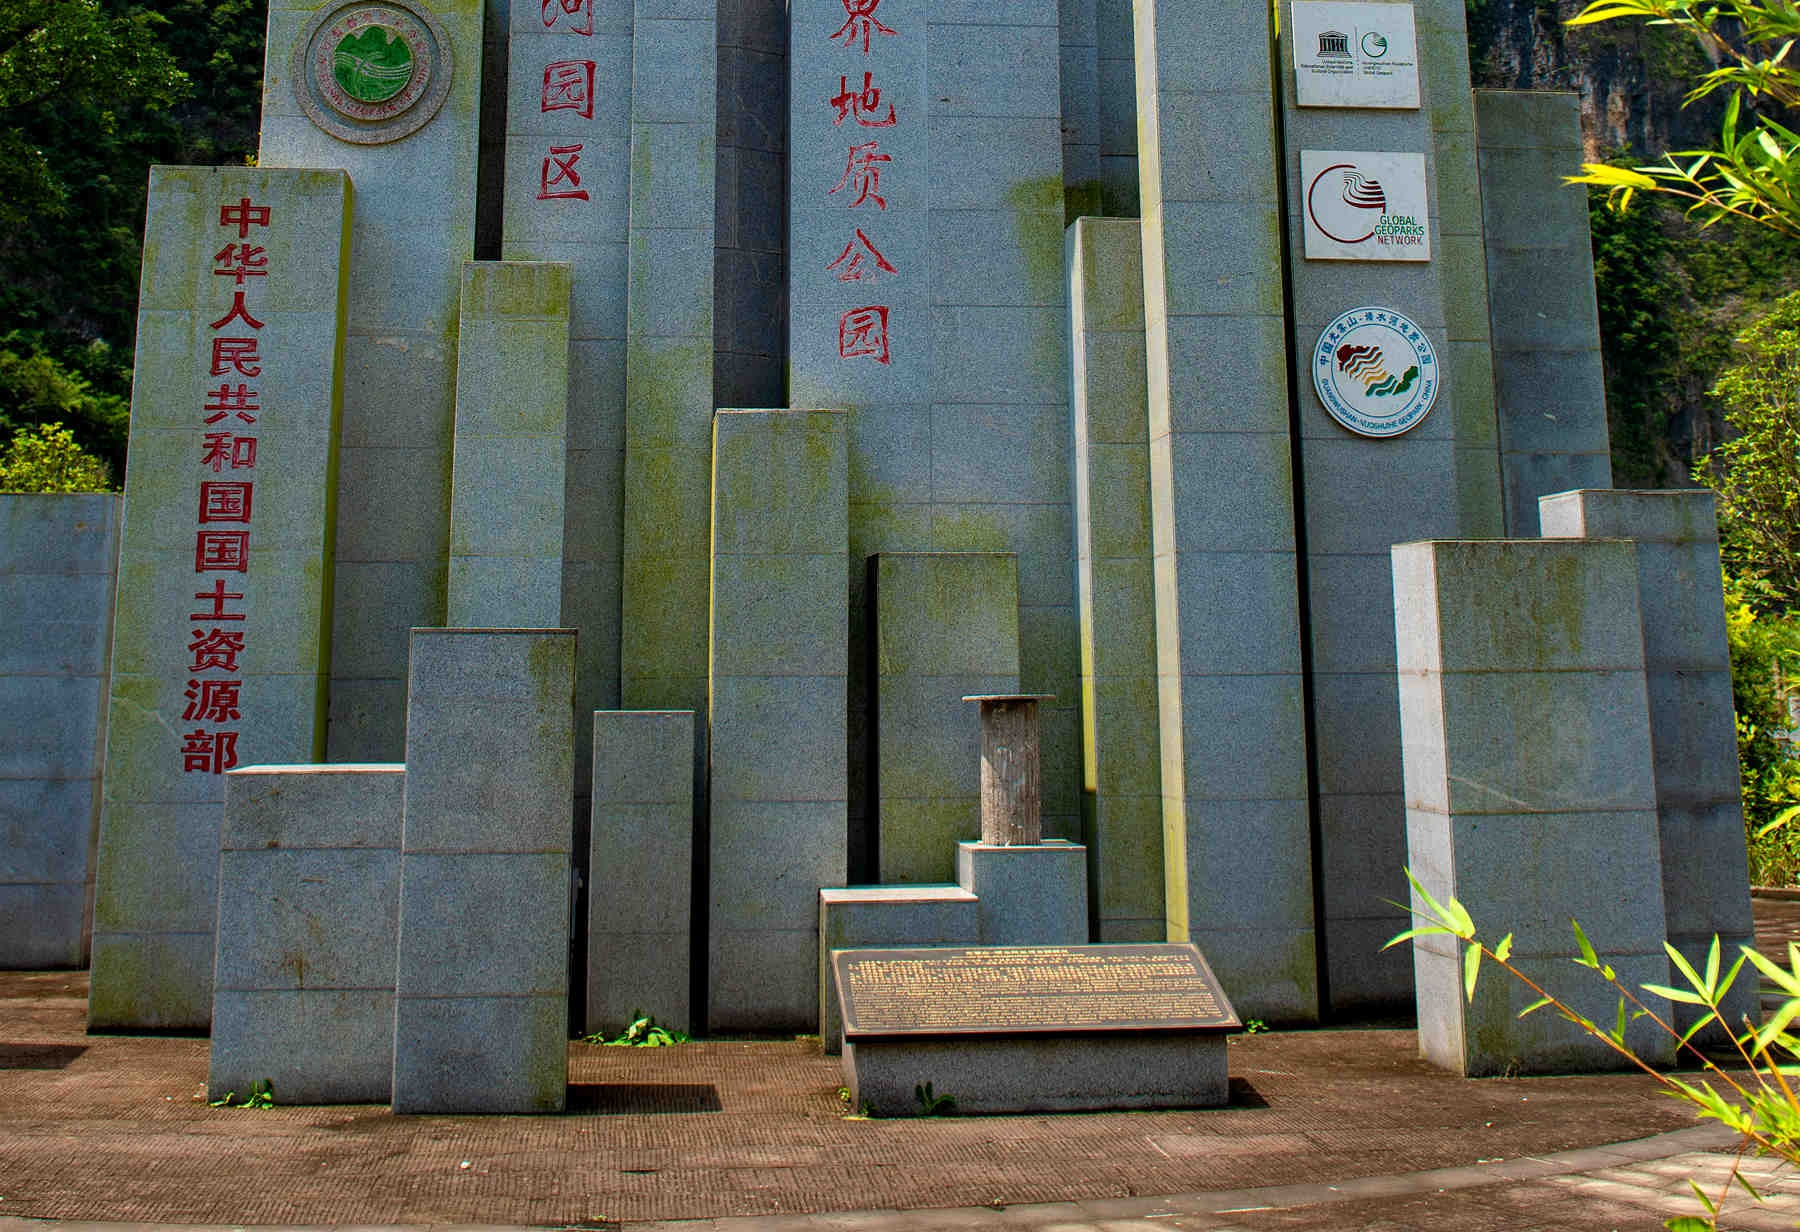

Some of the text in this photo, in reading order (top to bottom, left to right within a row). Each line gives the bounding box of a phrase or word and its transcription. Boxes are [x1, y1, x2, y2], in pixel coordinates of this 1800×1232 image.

[1380, 215, 1418, 225] GLOBAL
[1375, 225, 1425, 236] GEOPARKS
[1377, 235, 1424, 245] NETWORK
[181, 198, 272, 774] 中华人民共和国国土资源部
